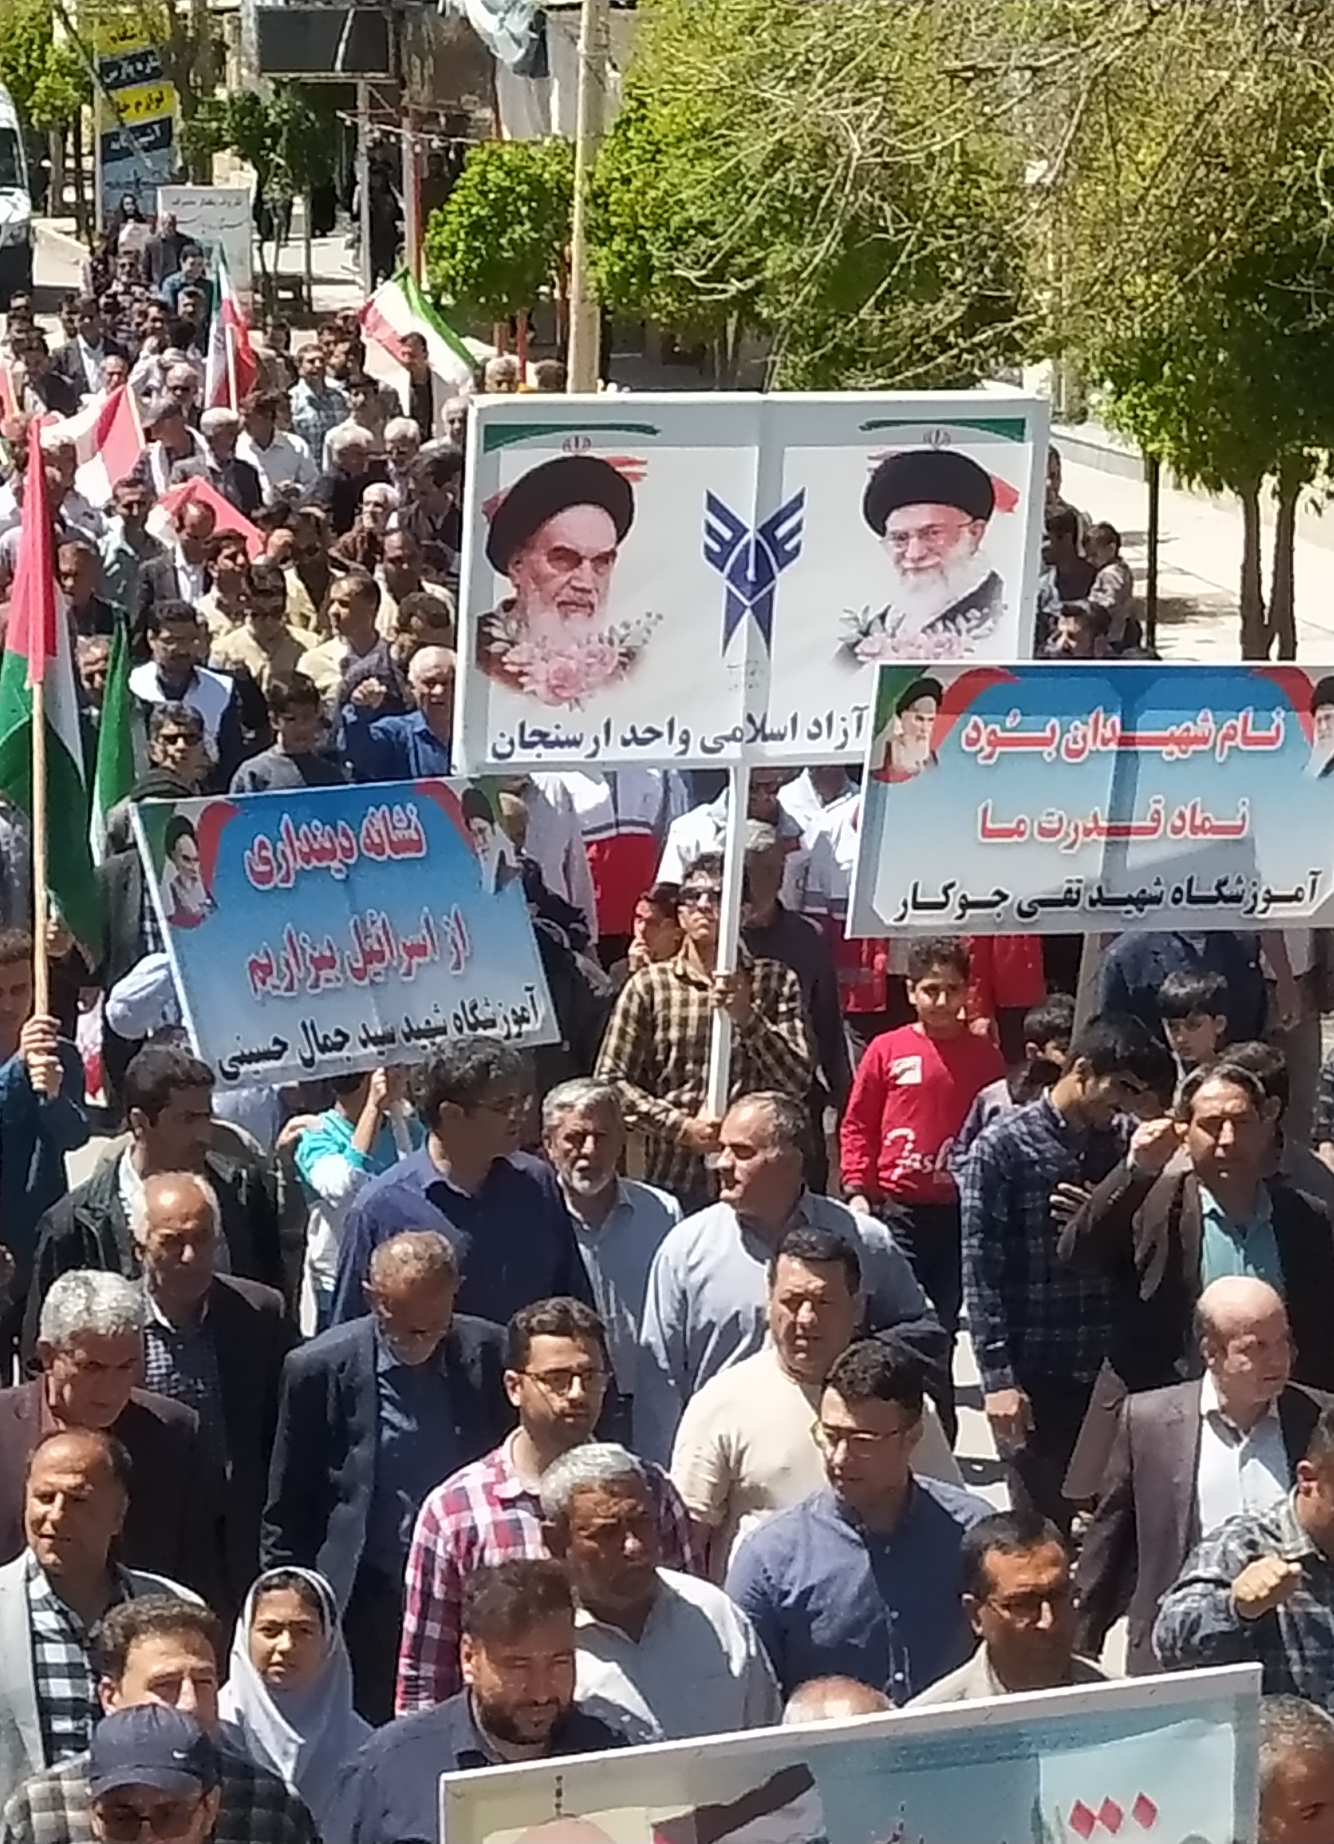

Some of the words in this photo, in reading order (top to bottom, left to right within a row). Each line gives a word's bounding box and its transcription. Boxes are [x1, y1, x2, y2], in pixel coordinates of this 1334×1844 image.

[491, 719, 613, 760] ارسنجان
[620, 717, 692, 750] واحد
[700, 710, 798, 753] اسلامی
[804, 704, 867, 752] آزاد
[1063, 708, 1212, 762] شهیدان
[1215, 712, 1283, 760] نام
[360, 803, 426, 859] نشانه
[979, 800, 1024, 841] ما
[1036, 795, 1162, 851] قدرت
[1168, 798, 1249, 839] نماد
[245, 815, 357, 889] دینداری
[893, 881, 1010, 923] جوکار
[1016, 876, 1084, 919] تقی
[1087, 876, 1164, 917] شهید
[1169, 870, 1322, 916] آموزشگاه
[248, 922, 339, 996] بیزاریم
[347, 907, 438, 984] اسرائیل
[445, 904, 469, 975] از
[401, 1003, 447, 1050] شهید
[453, 985, 541, 1039] آموزشگاه
[219, 1032, 289, 1083] حسینی
[298, 1019, 351, 1069] جمال
[356, 1023, 397, 1057] سید
